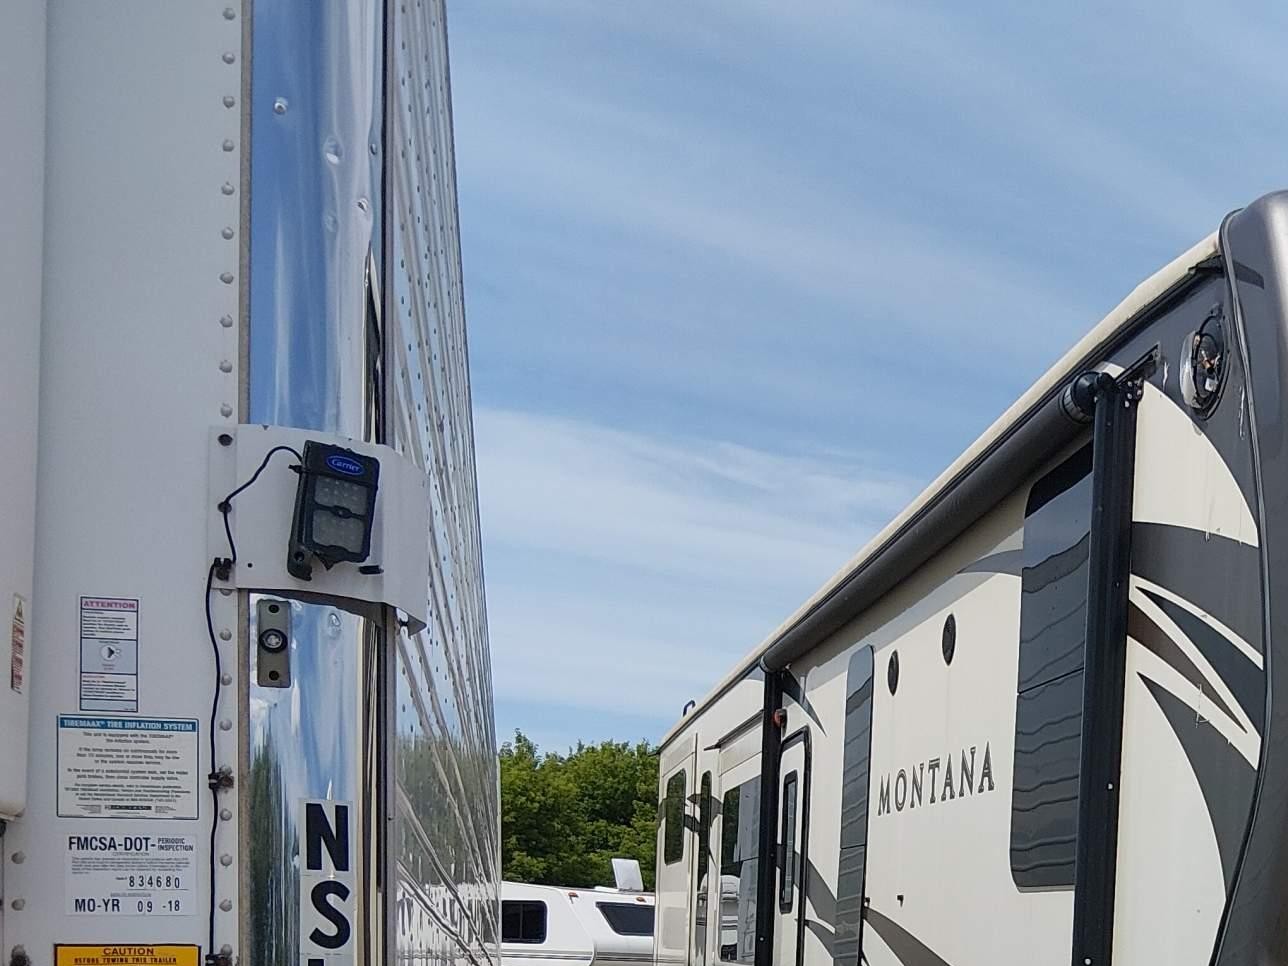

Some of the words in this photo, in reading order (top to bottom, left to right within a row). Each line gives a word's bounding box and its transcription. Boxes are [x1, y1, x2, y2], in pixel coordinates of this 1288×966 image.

[331, 458, 360, 472] Carrier
[83, 600, 136, 609] ATTENTION
[107, 720, 123, 729] TIRE
[124, 721, 161, 730] INFLATION
[163, 722, 193, 731] SYSTEM
[877, 740, 995, 817] MONTANA
[129, 875, 180, 888] 834680
[75, 899, 120, 912] MO-YR
[137, 901, 153, 912] 09
